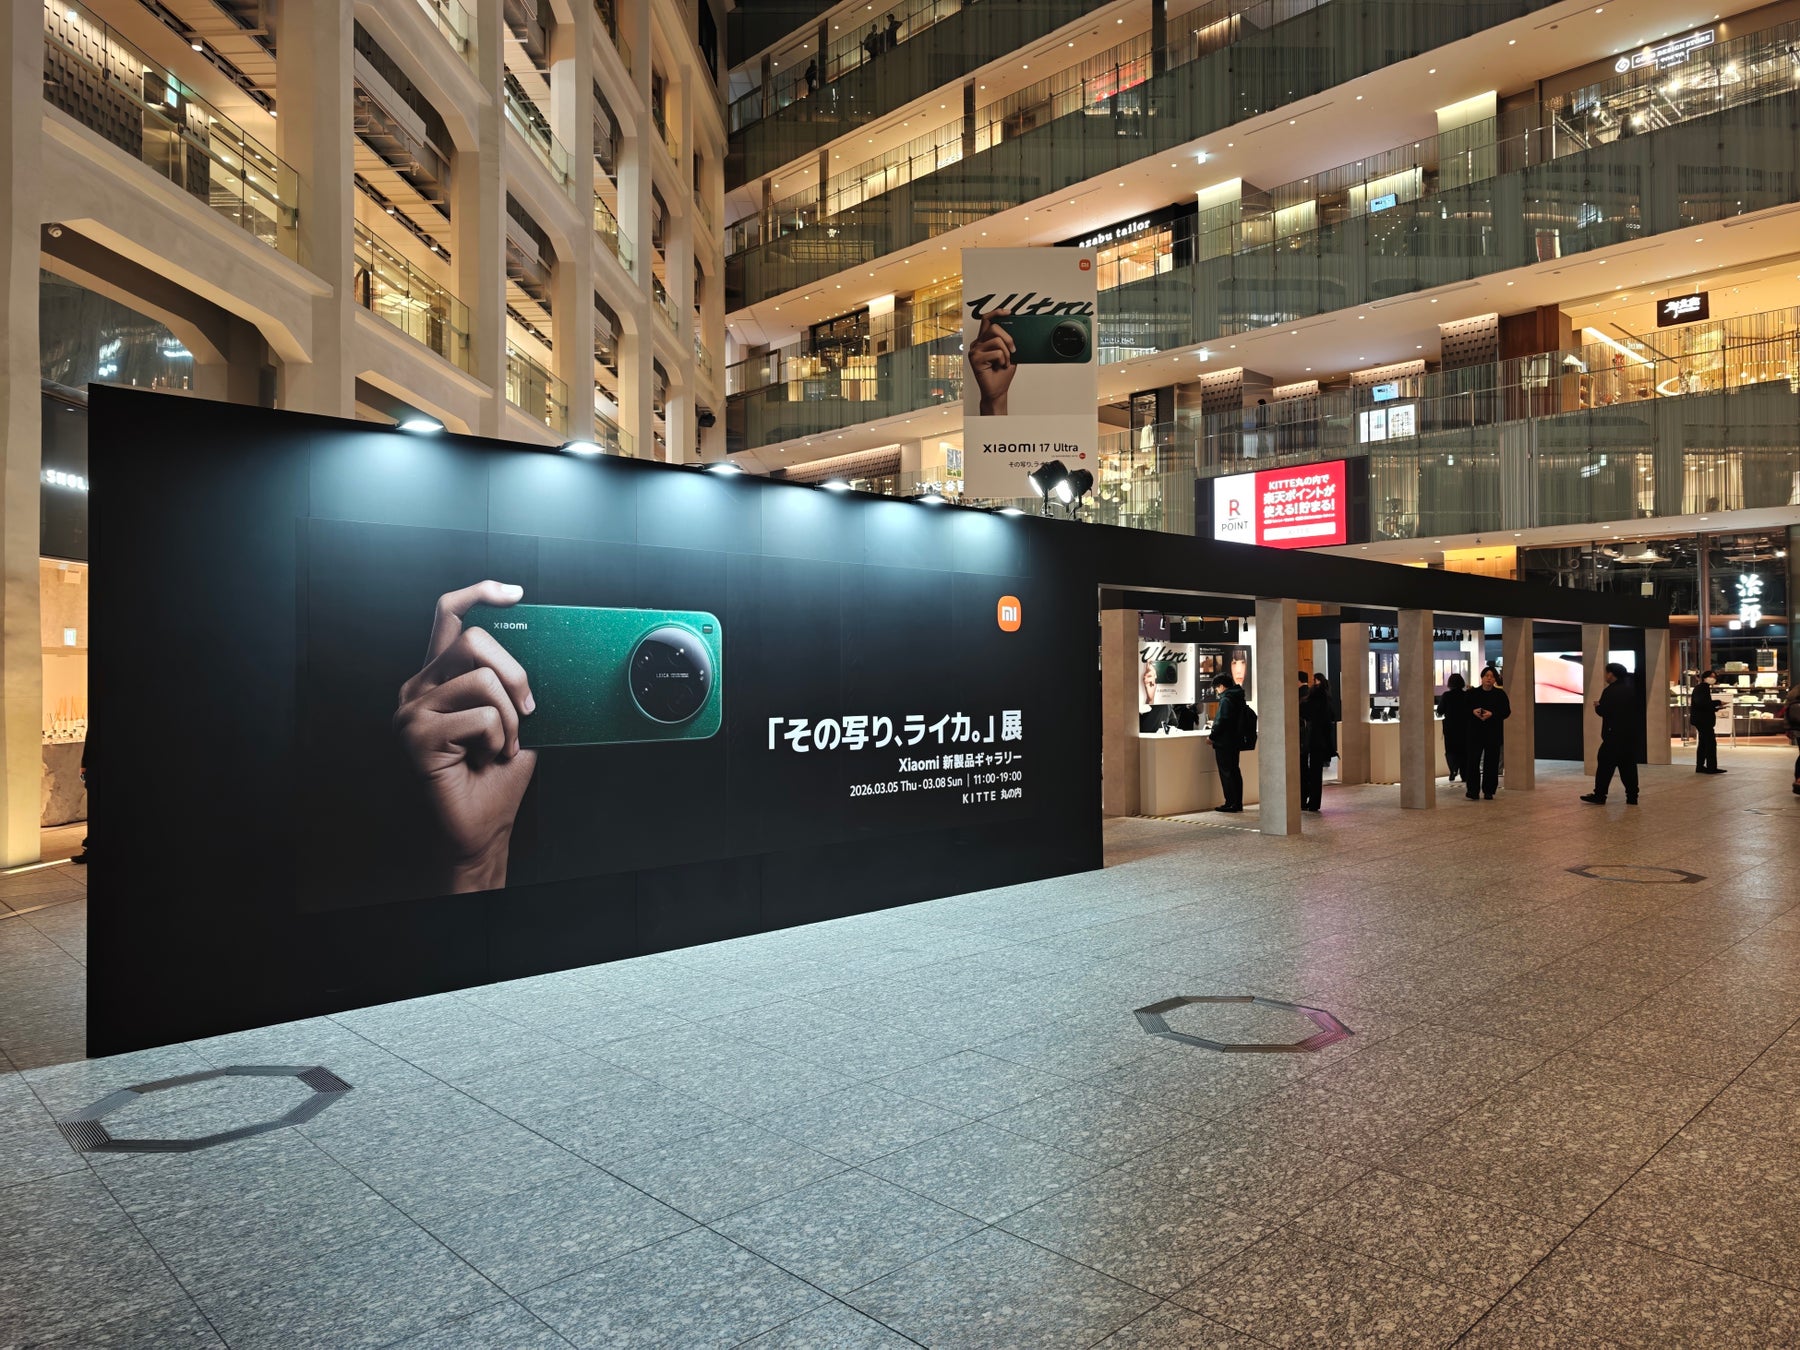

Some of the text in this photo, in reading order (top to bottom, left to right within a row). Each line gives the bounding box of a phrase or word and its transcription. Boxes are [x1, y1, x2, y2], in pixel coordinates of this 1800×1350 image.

[1685, 35, 1711, 47] STORE
[1079, 220, 1151, 248] azabu tailor
[966, 292, 1095, 321] Ultra
[1040, 443, 1050, 453] 17
[1053, 443, 1079, 453] Ultra
[1263, 484, 1336, 505] 楽天ポイントが
[1229, 499, 1241, 516] R
[1221, 521, 1248, 532] POINT
[1140, 646, 1187, 663] Ultra
[899, 751, 1022, 773] Xiaomi 新製品ギャラリー
[850, 782, 898, 797] 2026.03.05
[900, 780, 917, 792] Thu
[947, 775, 963, 787] Sun
[973, 771, 1022, 785] 11:00-19:00
[962, 788, 1022, 804] KITTE 丸の内
